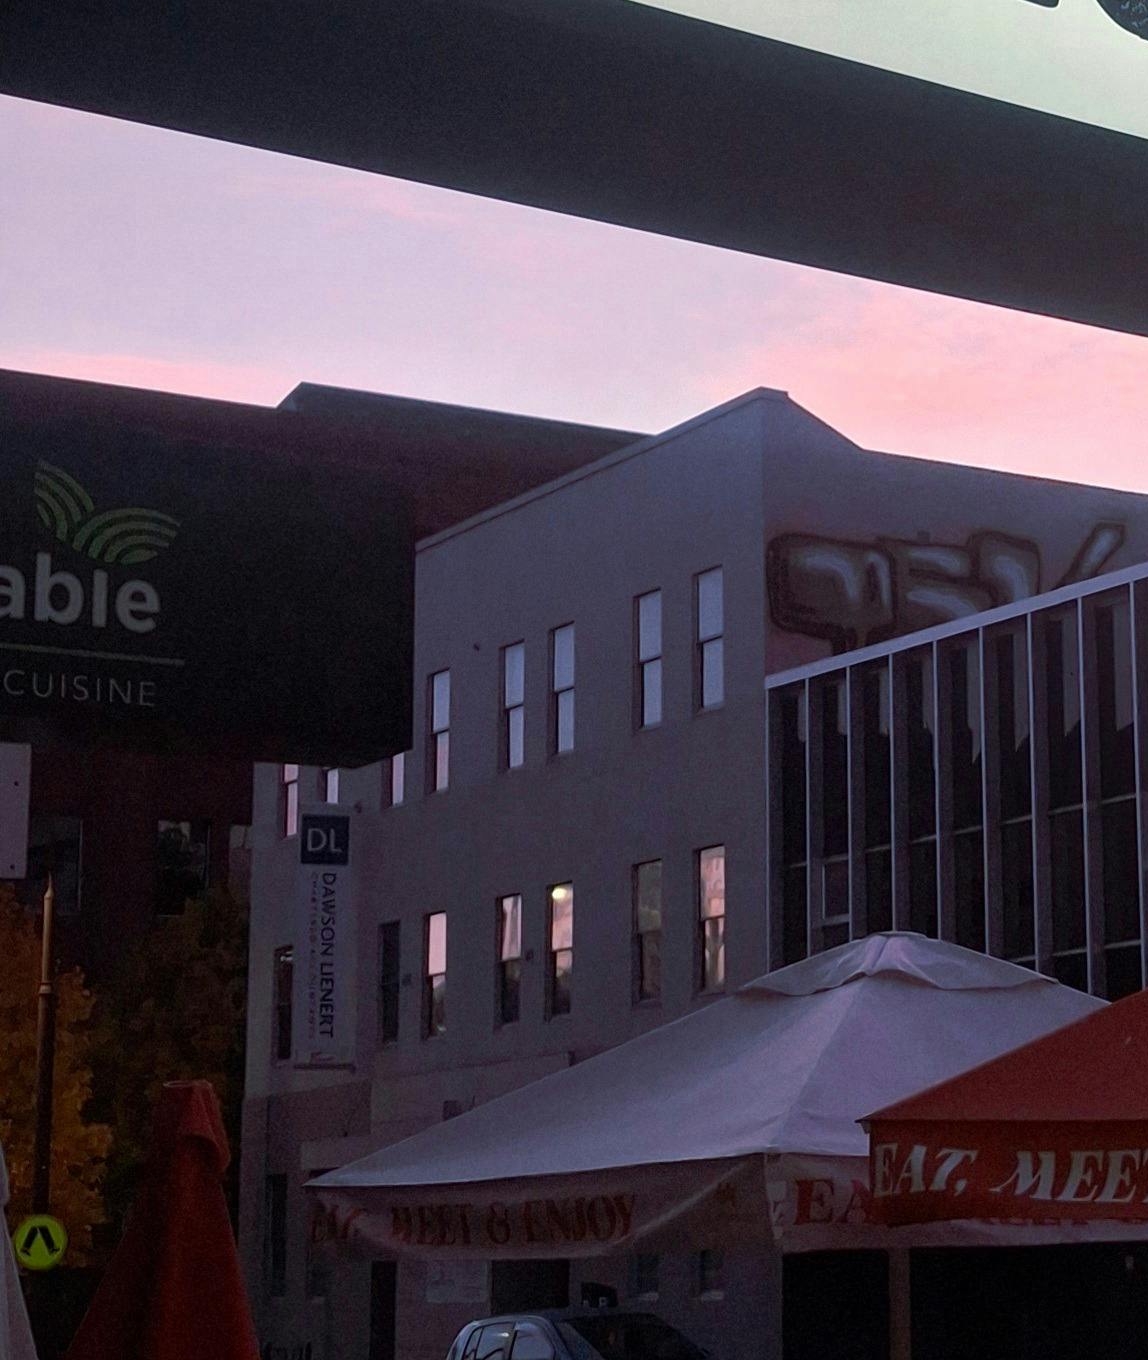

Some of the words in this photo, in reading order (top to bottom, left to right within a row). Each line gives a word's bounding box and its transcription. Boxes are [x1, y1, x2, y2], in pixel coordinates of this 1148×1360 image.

[3, 669, 156, 707] CUISINE
[306, 827, 343, 852] DL
[320, 872, 337, 957] DAWSON
[319, 962, 335, 1038] LIENERT
[522, 1193, 636, 1243] ENJOY
[794, 1178, 871, 1226] EA
